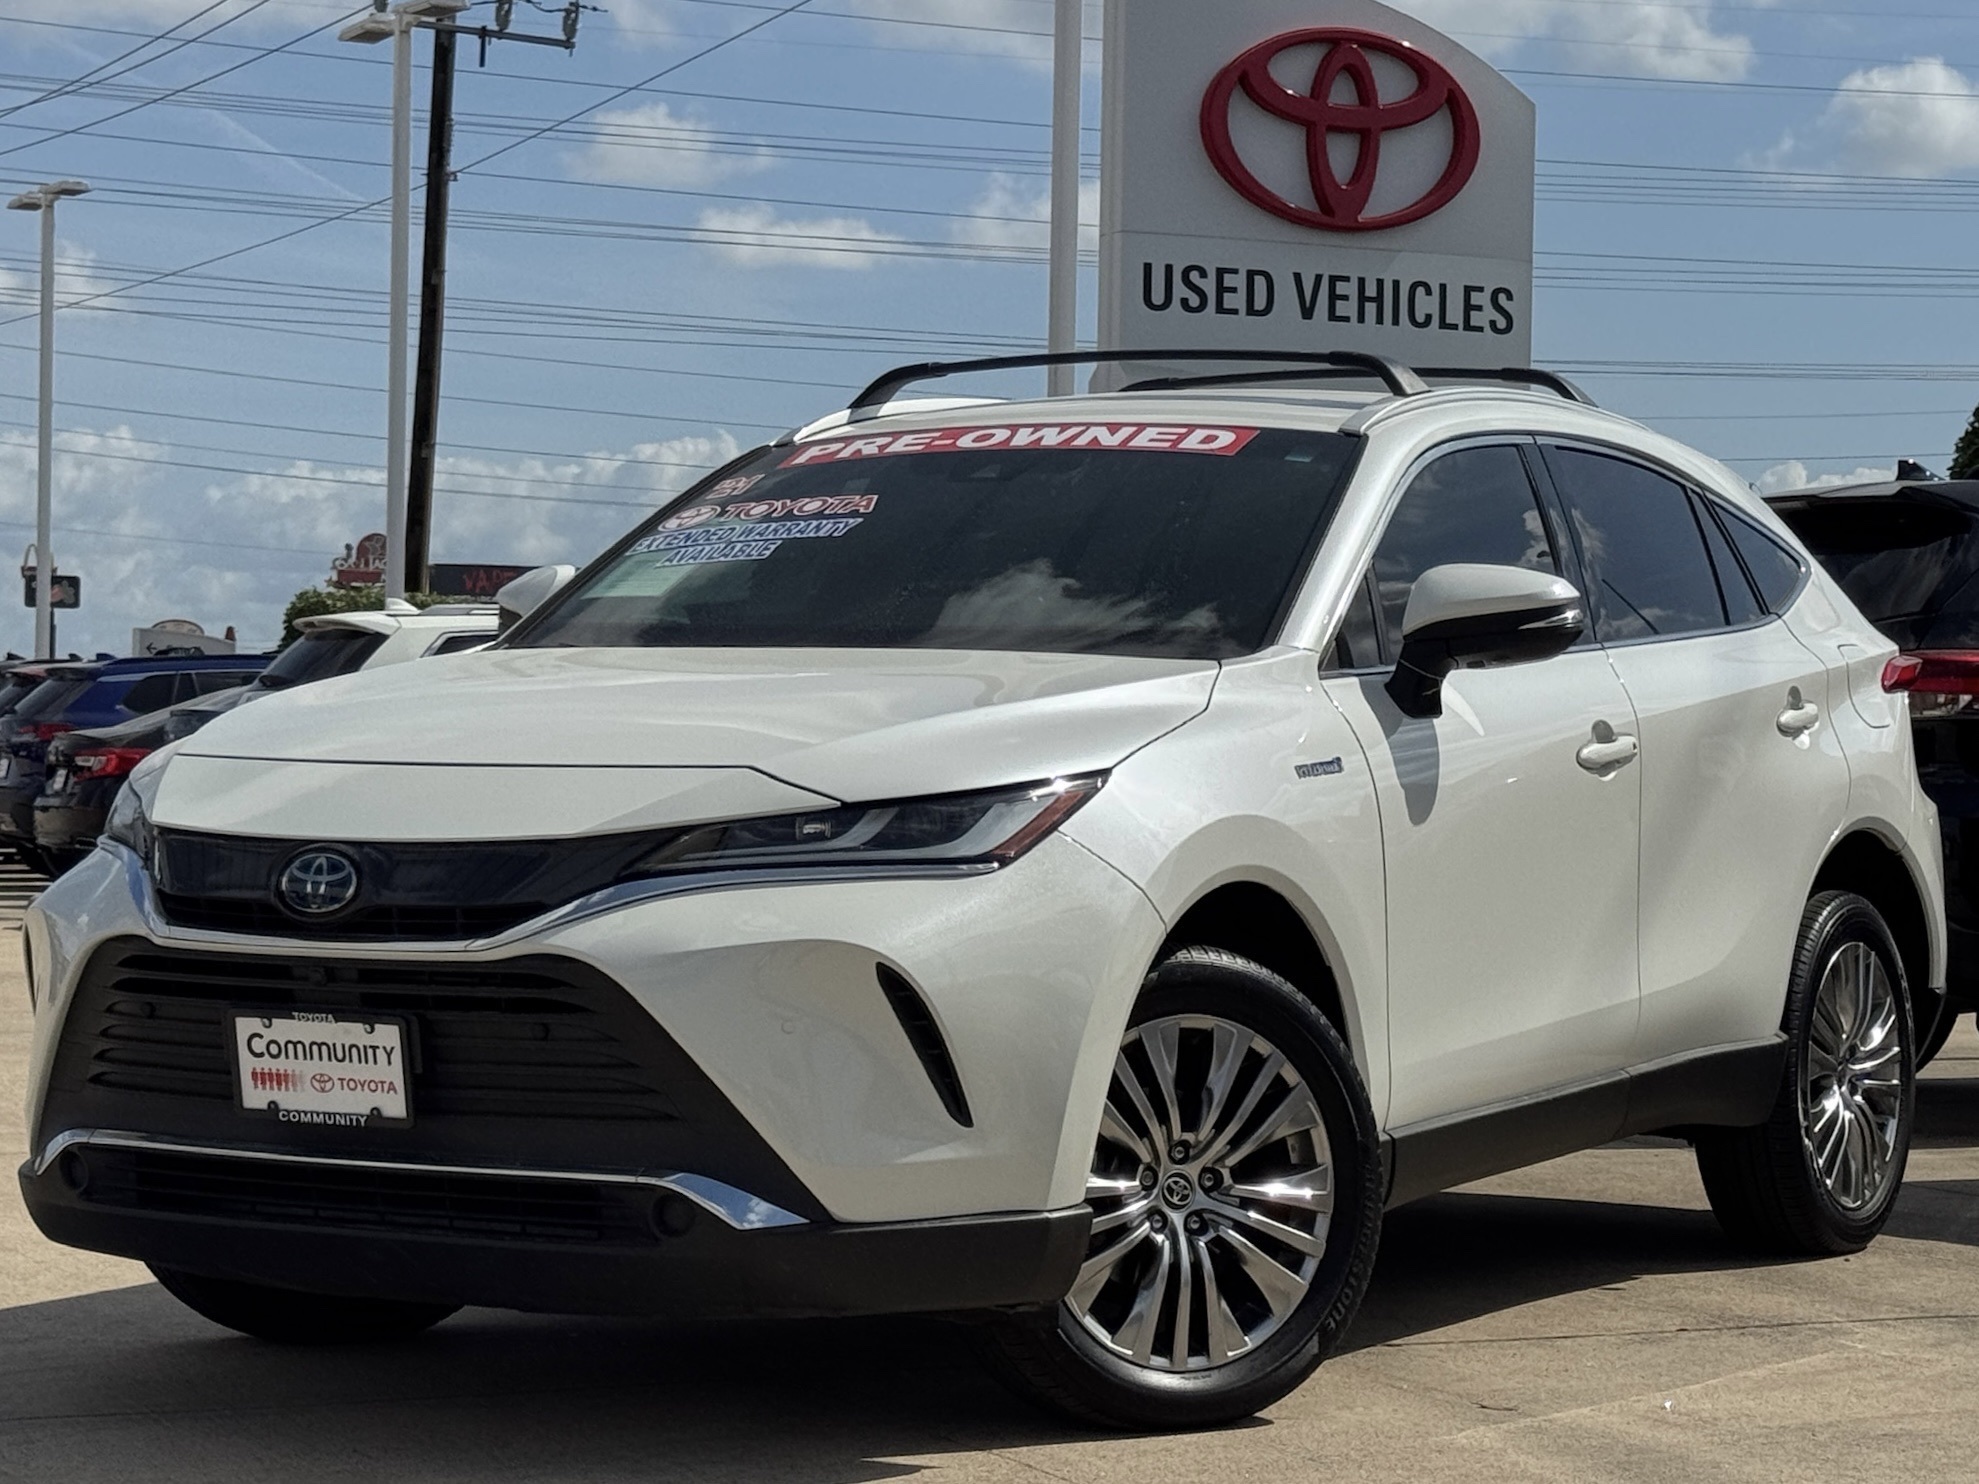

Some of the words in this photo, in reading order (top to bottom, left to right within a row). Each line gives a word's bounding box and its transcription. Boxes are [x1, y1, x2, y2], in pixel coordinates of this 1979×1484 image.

[1142, 262, 1275, 318] USED
[1292, 271, 1514, 335] VEHICLES
[791, 426, 1236, 465] PRE-OWNED
[720, 494, 879, 522] TOYOTA
[629, 526, 738, 554] EXTENDED
[737, 519, 860, 540] WARRANTY
[660, 540, 778, 566] AVAILABLE
[292, 1011, 337, 1024] TOYOTA
[338, 1077, 398, 1095] TOYOTA
[278, 1110, 368, 1127] COMMUNITY
